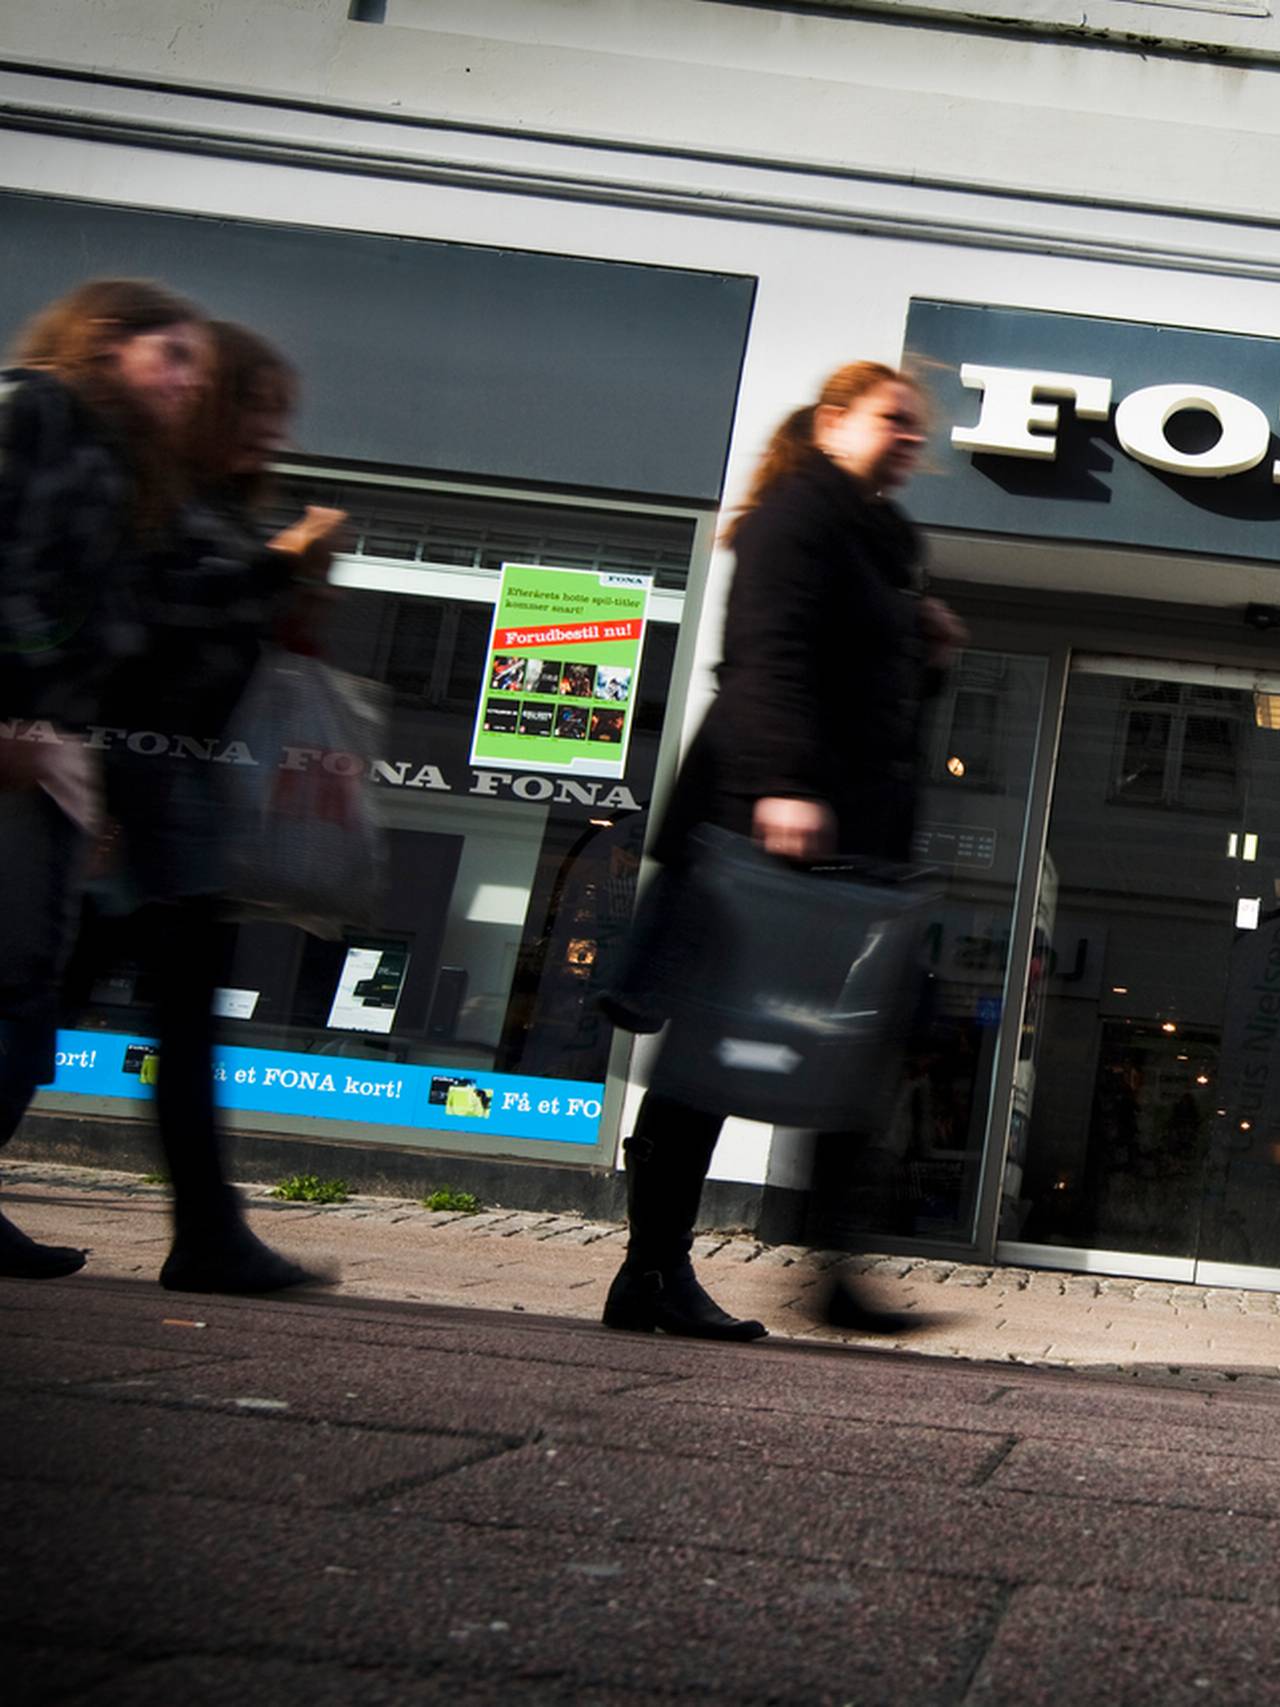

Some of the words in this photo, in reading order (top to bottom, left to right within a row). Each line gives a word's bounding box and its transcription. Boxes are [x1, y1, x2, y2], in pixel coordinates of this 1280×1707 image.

[505, 600, 549, 612] kommer
[505, 626, 600, 645] Forudbestil
[603, 623, 632, 638] nu!
[82, 725, 260, 766] FONA
[277, 745, 451, 790] FONA
[469, 770, 642, 811] FONA
[55, 1050, 96, 1068] ort!
[234, 1066, 257, 1084] et
[262, 1068, 336, 1092] FONA
[343, 1076, 402, 1099] kort!
[501, 1092, 532, 1113] Få
[537, 1097, 560, 1115] et
